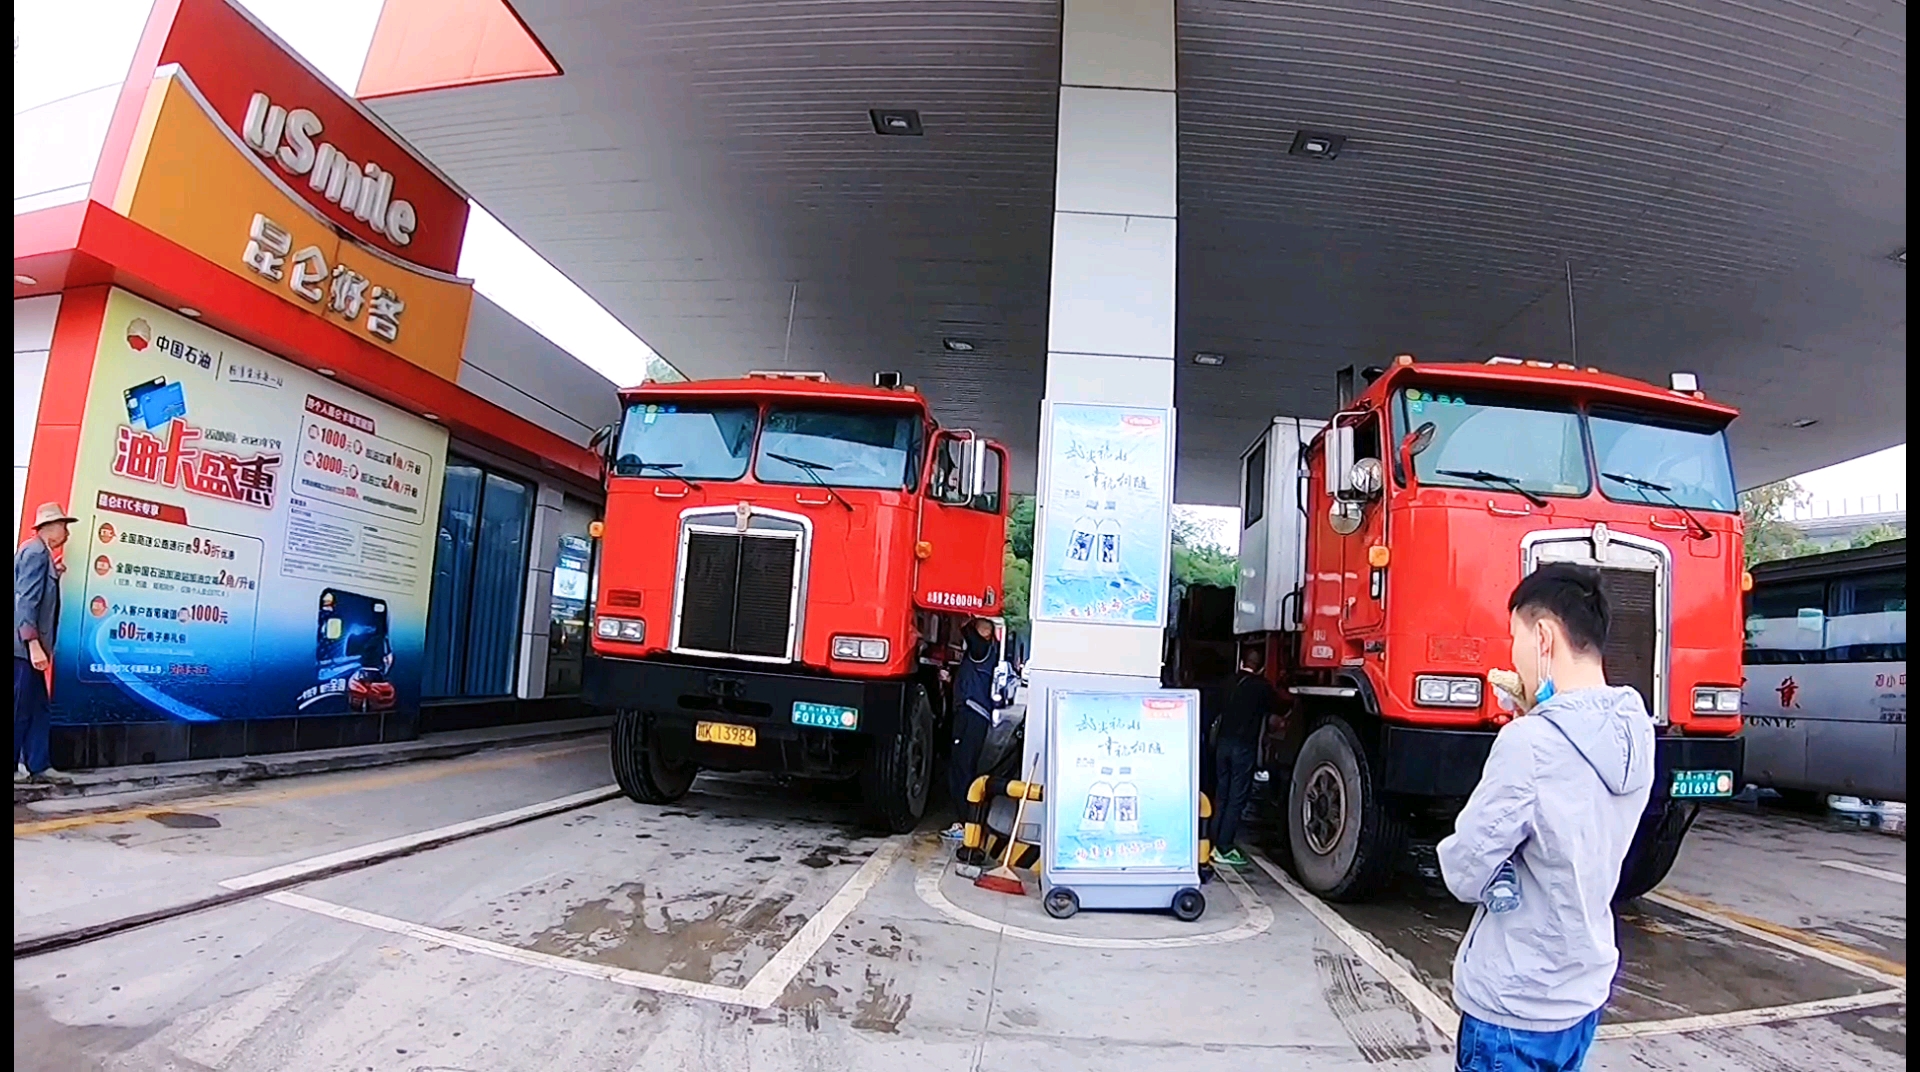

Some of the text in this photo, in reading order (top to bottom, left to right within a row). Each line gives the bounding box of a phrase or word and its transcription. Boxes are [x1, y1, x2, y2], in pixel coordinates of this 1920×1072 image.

[243, 91, 417, 246] uSmile
[243, 212, 406, 342] 昆仑好客
[157, 335, 212, 370] 中国石油
[114, 418, 281, 507] 油卡盛惠
[795, 712, 839, 727] F01693
[1673, 782, 1715, 794] F01698
